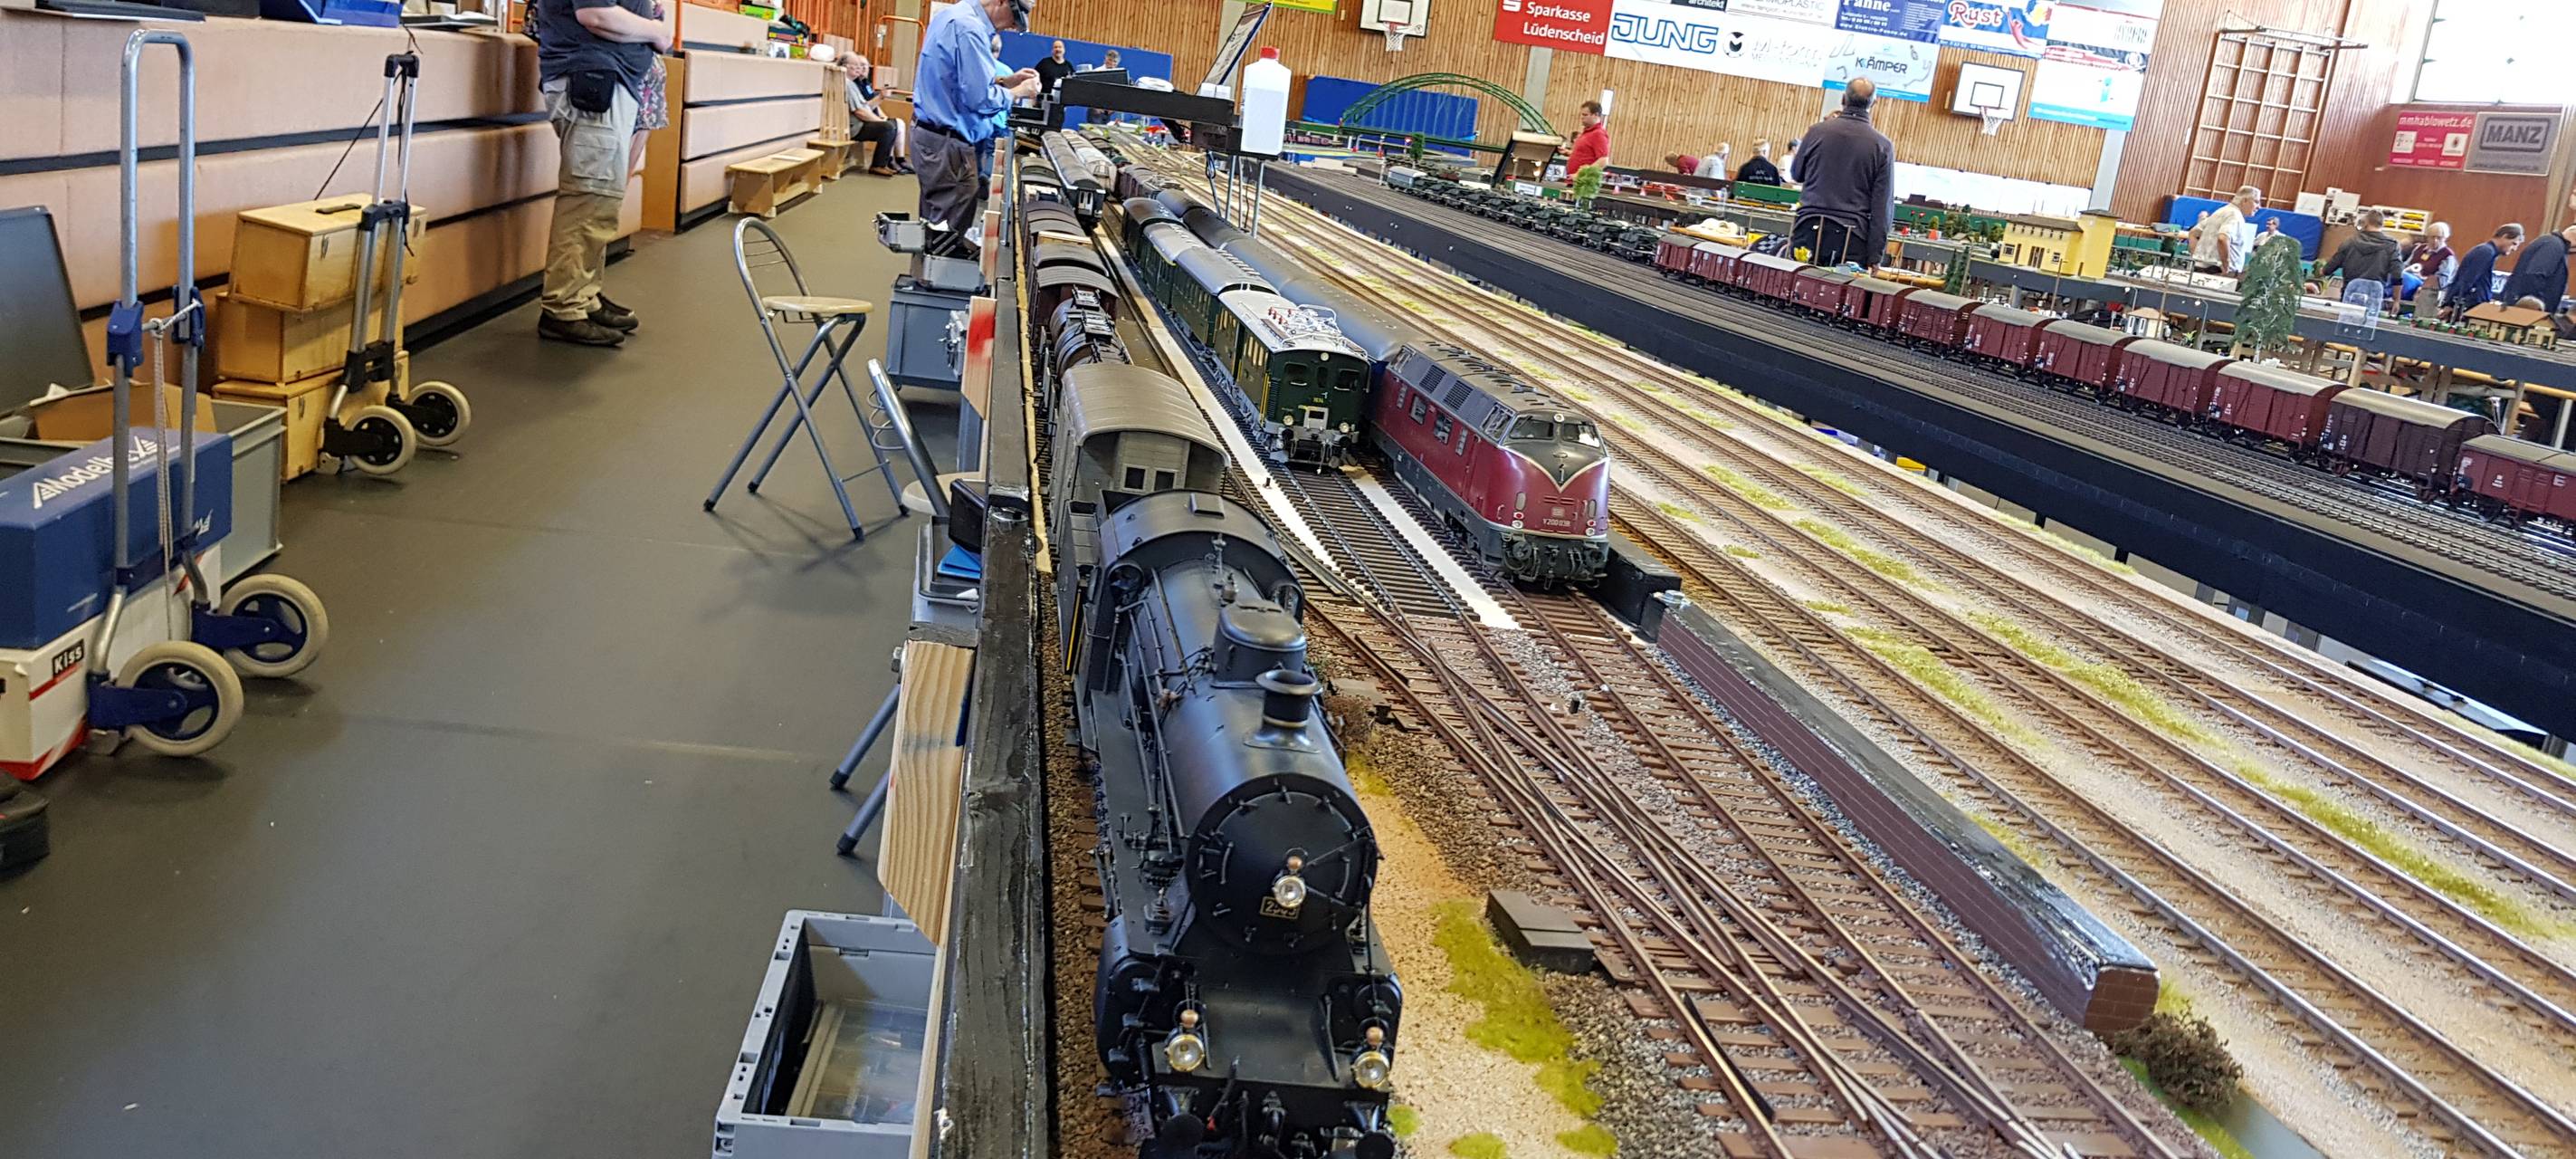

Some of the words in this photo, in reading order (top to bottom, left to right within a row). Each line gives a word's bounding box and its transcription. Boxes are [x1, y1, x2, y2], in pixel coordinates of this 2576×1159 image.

[1526, 2, 1591, 23] Sparkasse
[1949, 1, 2002, 27] Rust
[1522, 21, 1605, 45] Lüdenscheid
[1611, 13, 1719, 54] JUNG
[2485, 125, 2543, 143] MANZ
